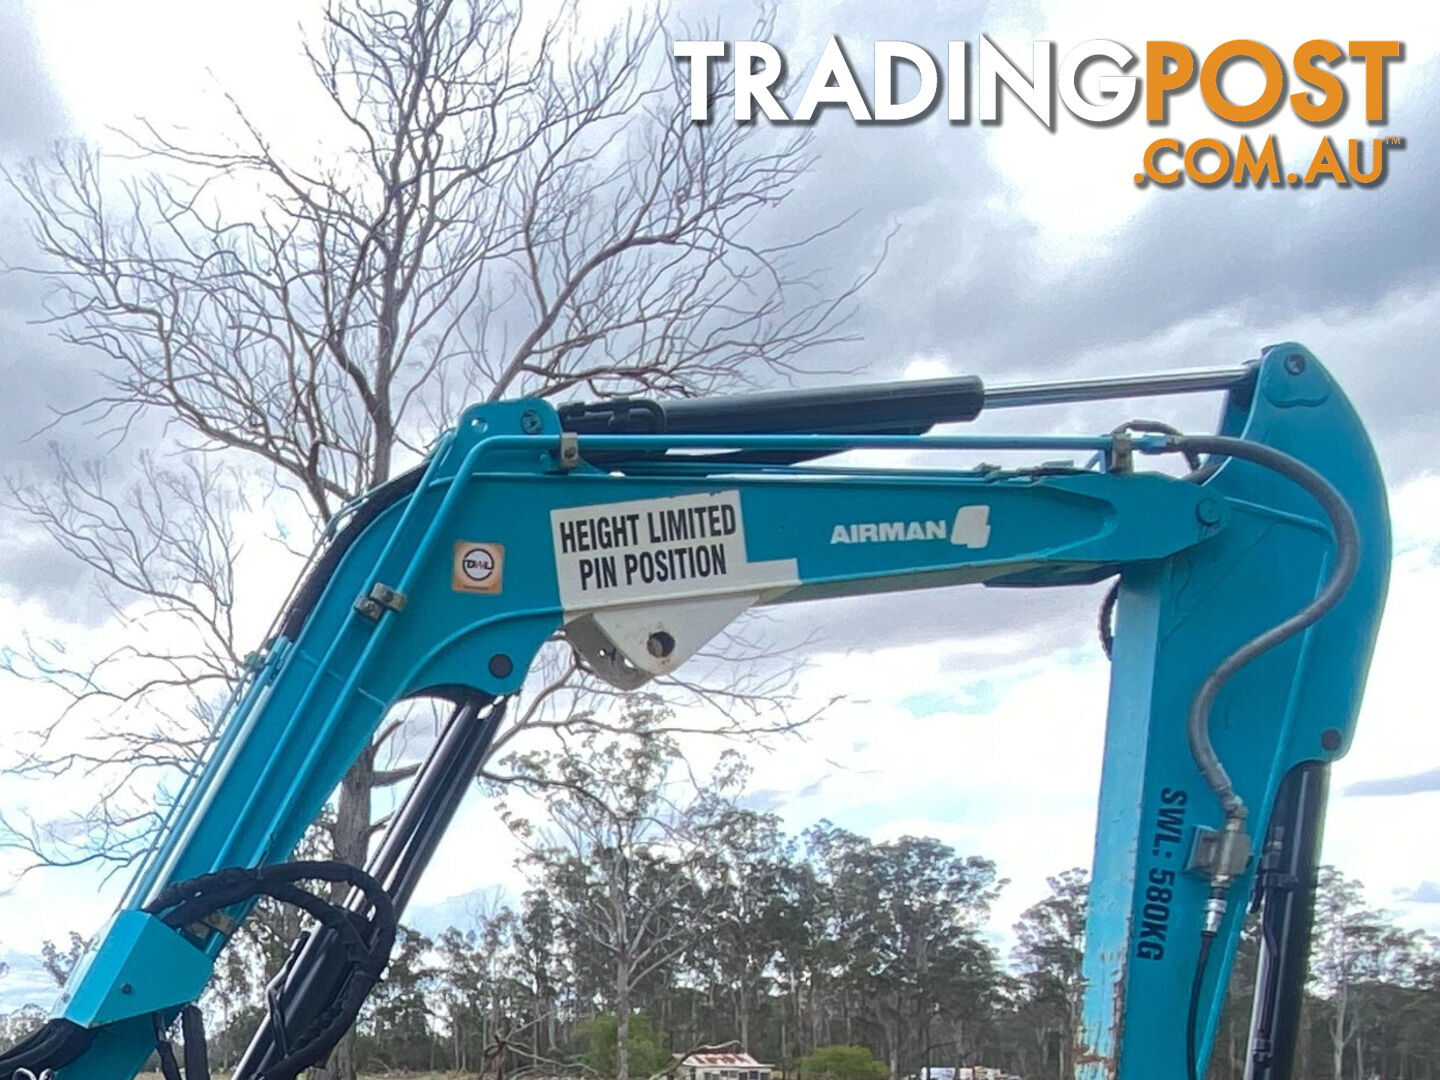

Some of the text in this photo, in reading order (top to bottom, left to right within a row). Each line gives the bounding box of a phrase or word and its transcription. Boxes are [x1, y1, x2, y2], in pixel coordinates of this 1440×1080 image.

[560, 504, 736, 553] HEIGHT LIMITED
[831, 519, 946, 545] AIRMAN
[579, 544, 727, 591] PIN POSITION
[1136, 868, 1176, 960] 580KG
